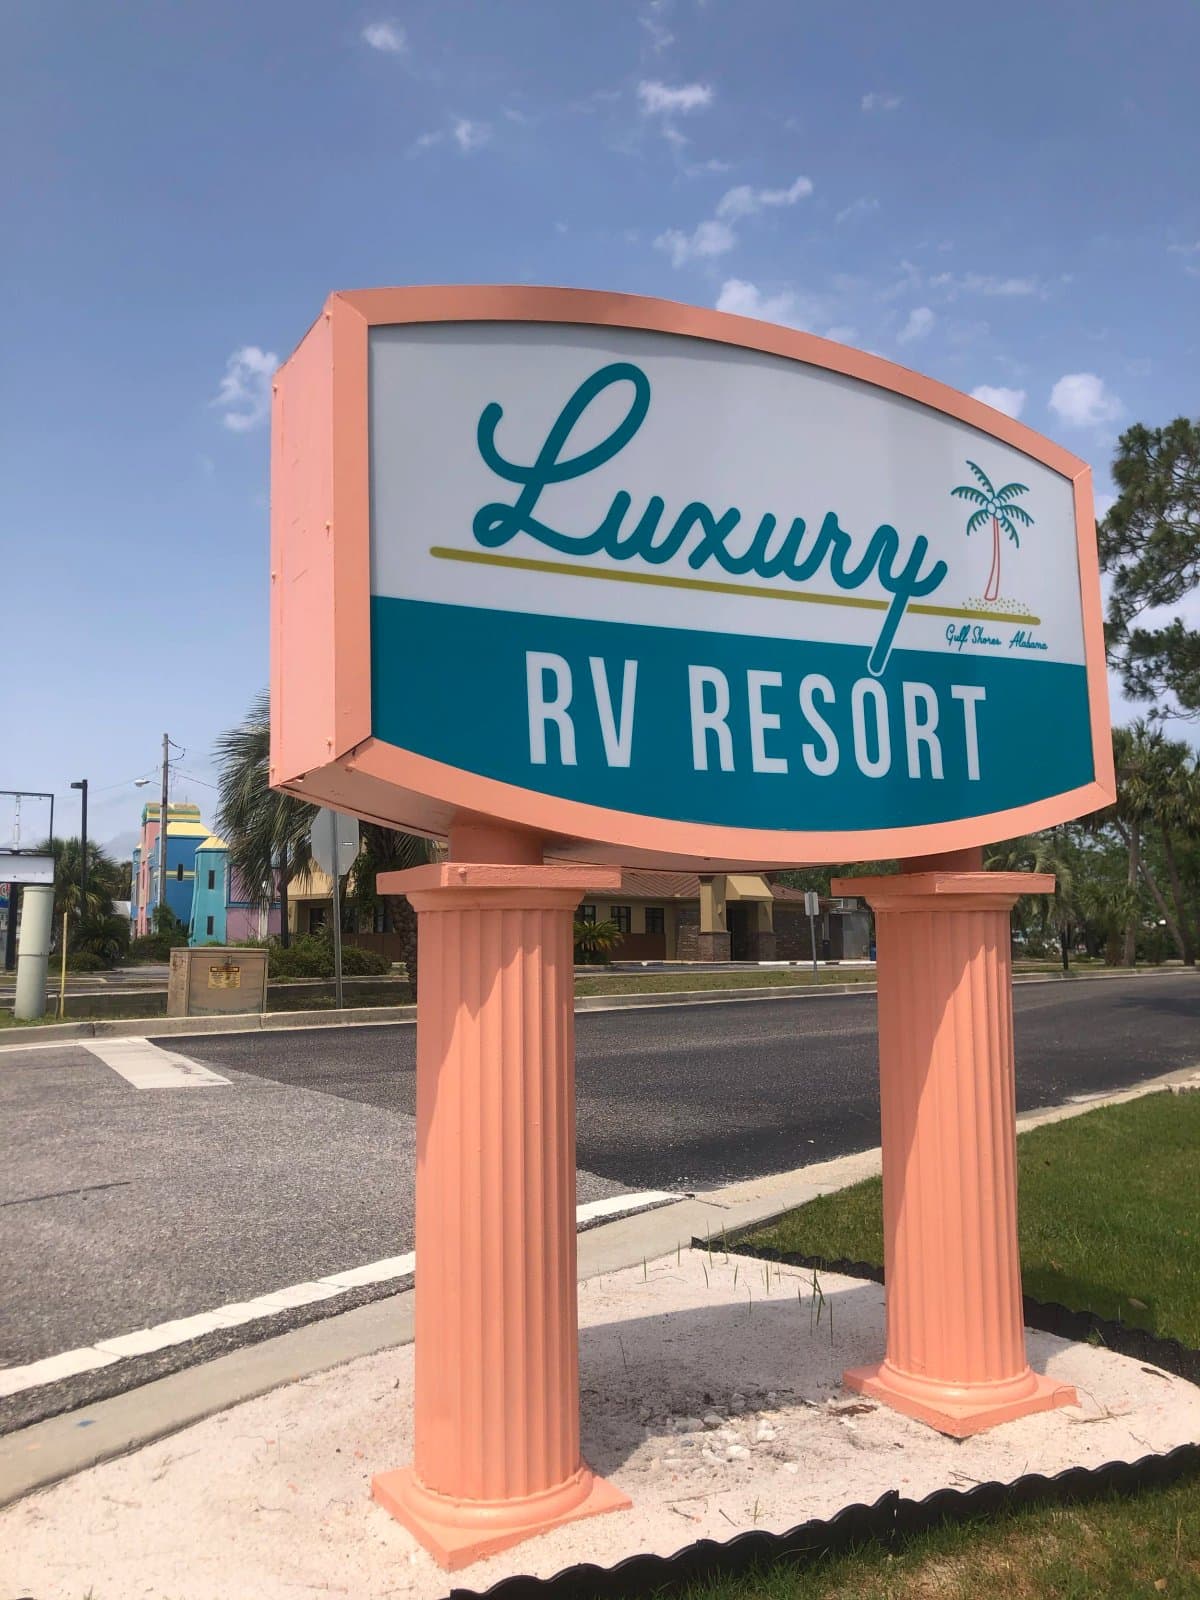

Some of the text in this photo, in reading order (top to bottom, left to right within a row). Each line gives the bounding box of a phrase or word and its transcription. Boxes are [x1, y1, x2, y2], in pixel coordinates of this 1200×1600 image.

[473, 362, 947, 673] Luxury
[946, 623, 1048, 651] Gulf Shores Alabama
[525, 651, 986, 780] RV RESORT
